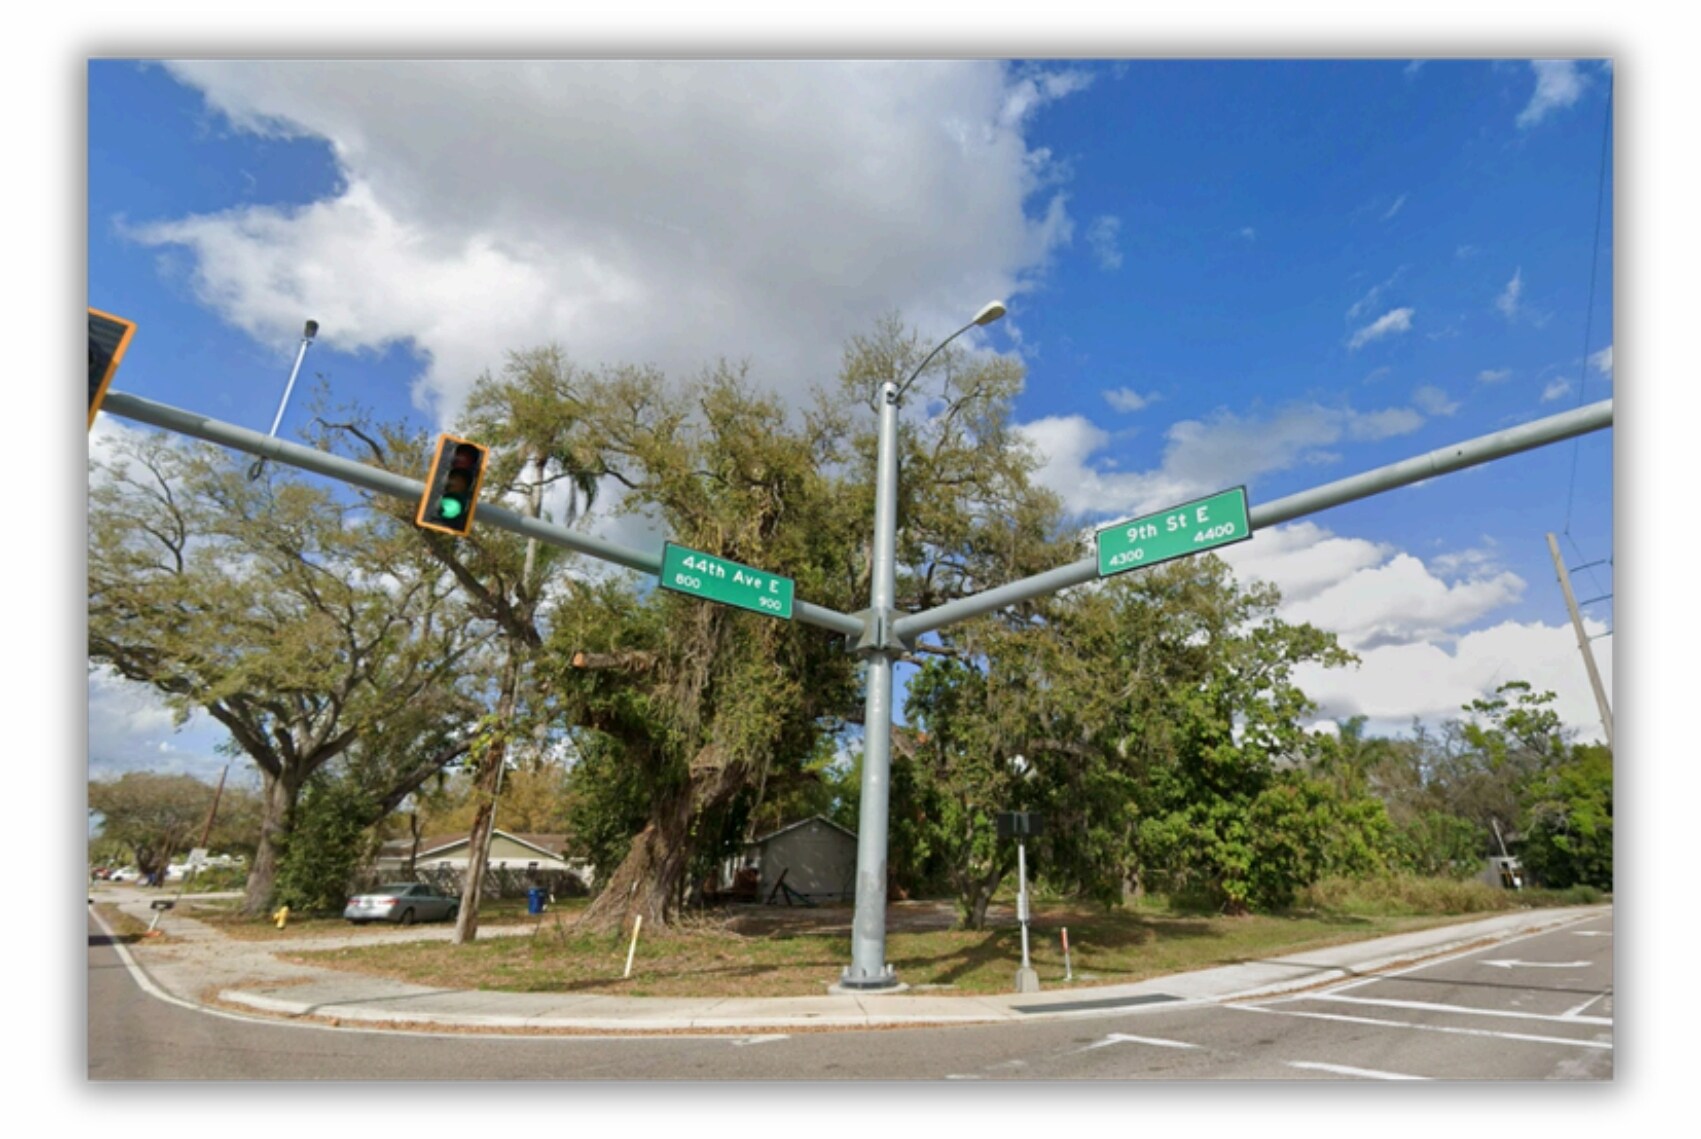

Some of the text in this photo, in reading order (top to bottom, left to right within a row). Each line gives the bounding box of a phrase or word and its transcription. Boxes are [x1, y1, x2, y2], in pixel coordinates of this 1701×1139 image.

[1127, 506, 1209, 543] 9th St E
[1194, 522, 1235, 542] 4400
[1109, 548, 1144, 566] 4300
[675, 572, 701, 589] 800
[682, 555, 780, 594] 44th Ave E
[758, 596, 782, 611] 900
